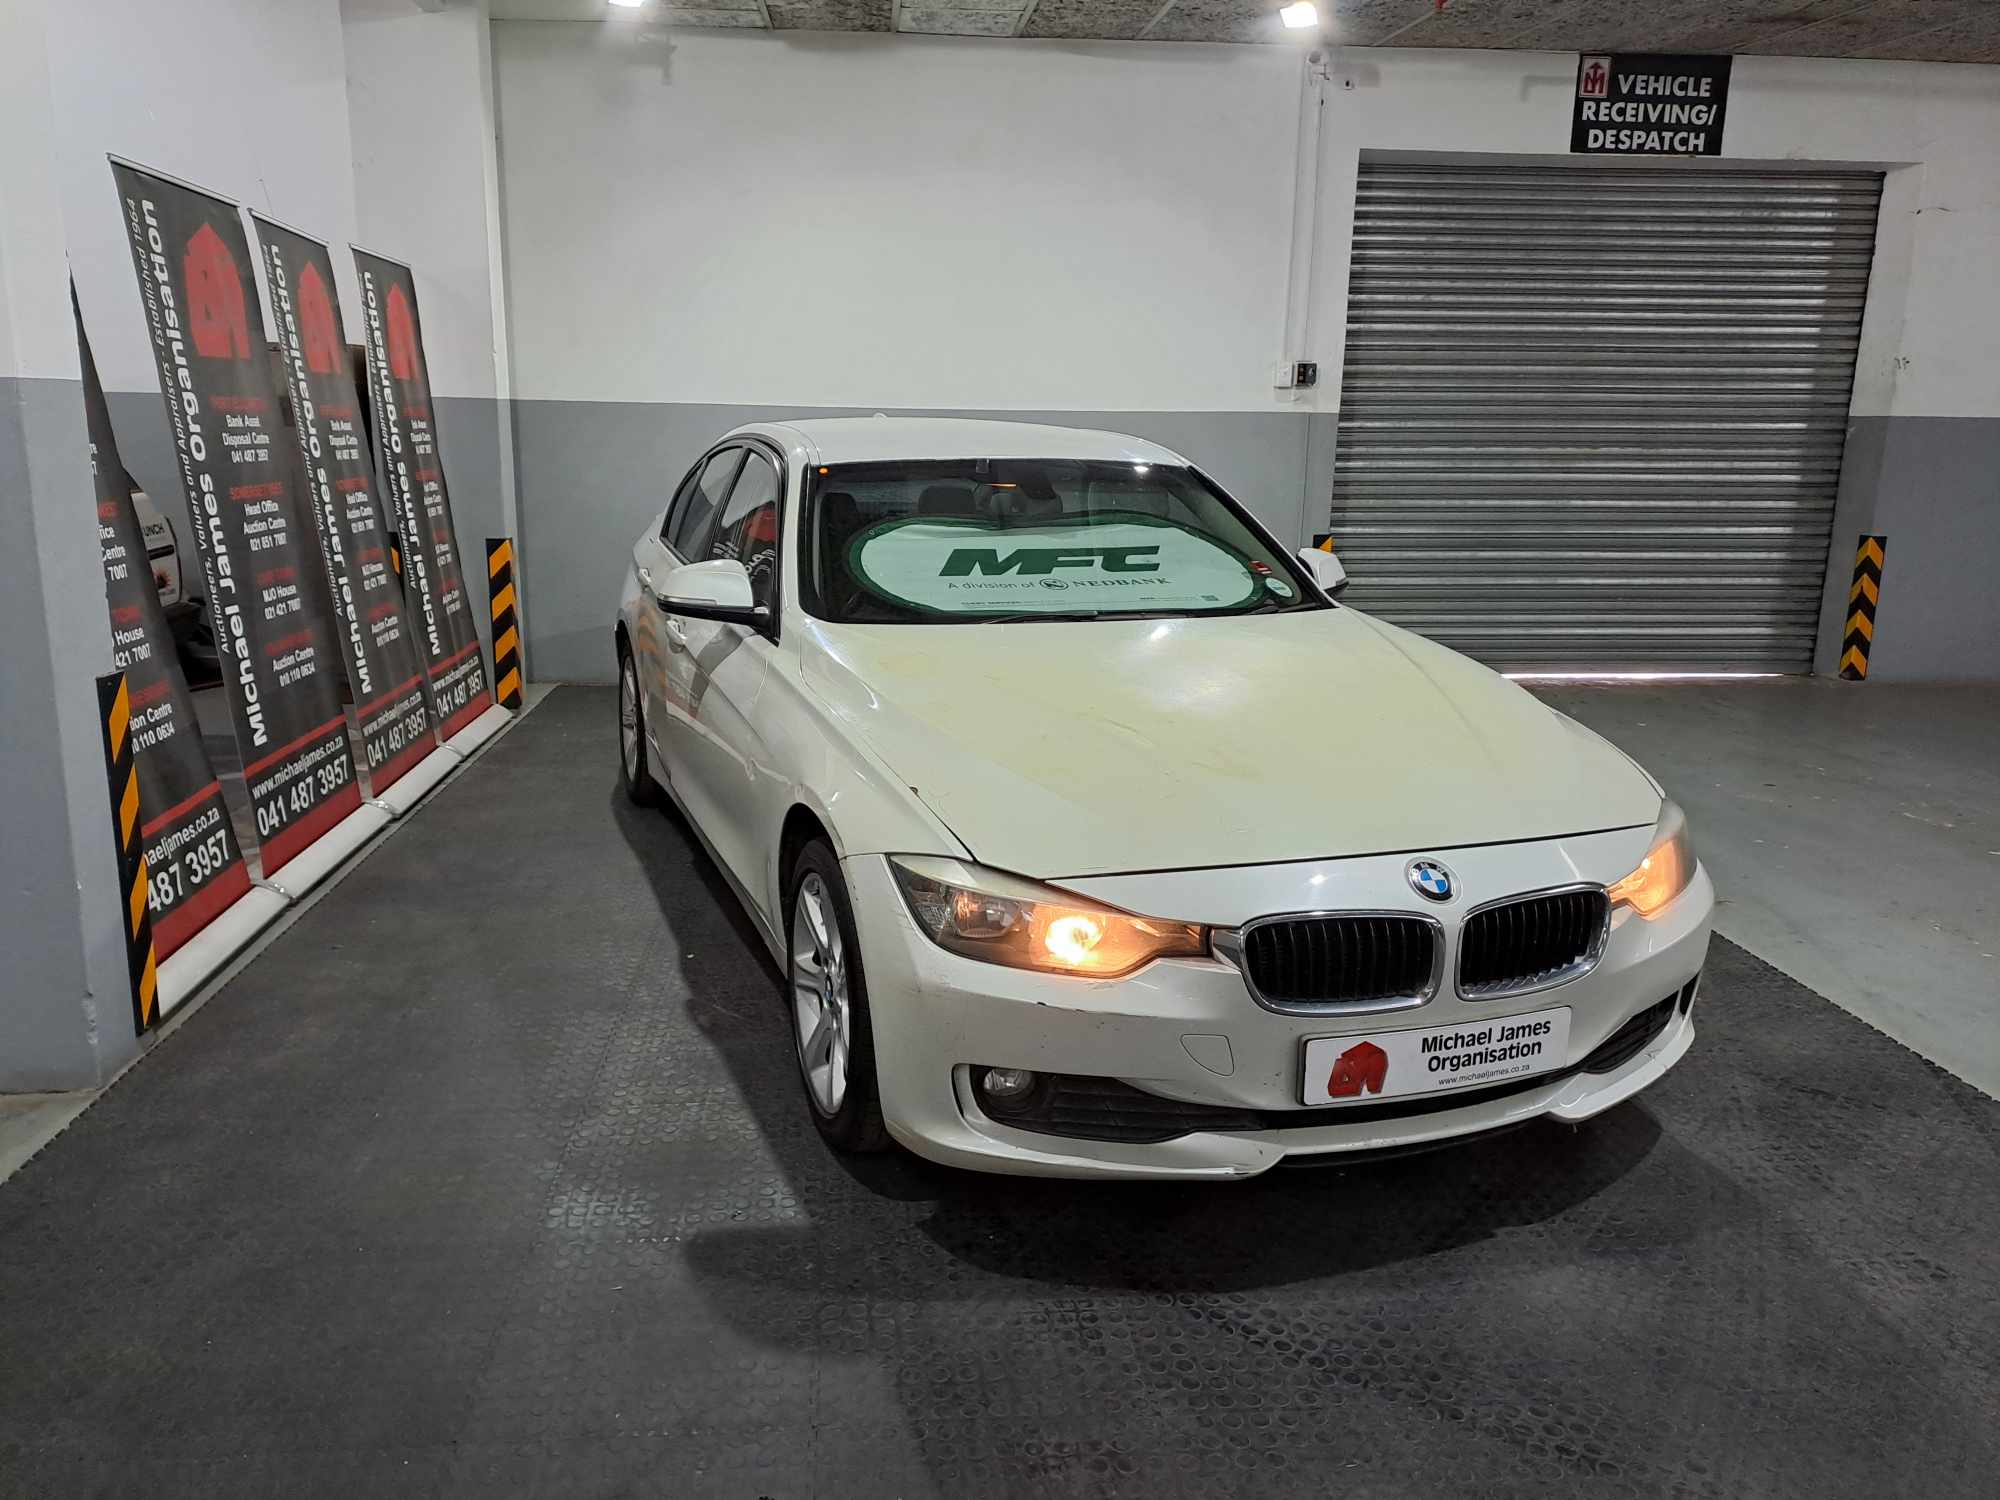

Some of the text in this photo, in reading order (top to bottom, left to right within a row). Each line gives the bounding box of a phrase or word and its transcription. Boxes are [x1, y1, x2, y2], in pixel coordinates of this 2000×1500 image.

[1618, 74, 1713, 97] VEHICLE
[1582, 101, 1718, 126] RECEIVING/
[1587, 128, 1705, 152] DESPATCH
[126, 198, 143, 241] 1964
[136, 246, 166, 346] Established
[271, 244, 321, 459] Organisation
[364, 271, 402, 454] Organisation
[162, 362, 187, 450] Appraisers
[222, 433, 251, 447] Disposal
[142, 200, 268, 747] Michael James Organisation
[182, 453, 194, 486] and
[189, 490, 208, 550] Valuers
[316, 467, 346, 567] James
[397, 461, 420, 547] James
[243, 521, 267, 535] Auction
[938, 545, 1160, 576] MFC
[948, 577, 1172, 590] A division of NEDBANK
[412, 554, 440, 655] Michael
[115, 626, 145, 647] House
[338, 576, 372, 694] Michael
[115, 643, 150, 668] 421 7007
[273, 654, 295, 672] Auction
[130, 702, 173, 731] tion Centre
[437, 691, 453, 718] 041
[139, 730, 156, 749] 110
[156, 721, 175, 742] 0634
[367, 707, 426, 767] 041 487 3957
[252, 735, 344, 800] www.michaeljames.co.za
[257, 754, 348, 836] 041 487 3957
[148, 828, 229, 912] 487 3957
[1421, 1020, 1551, 1054] Michael James
[1427, 1041, 1542, 1073] Organisation
[1438, 1064, 1531, 1087] www.michaeljames.co.za
